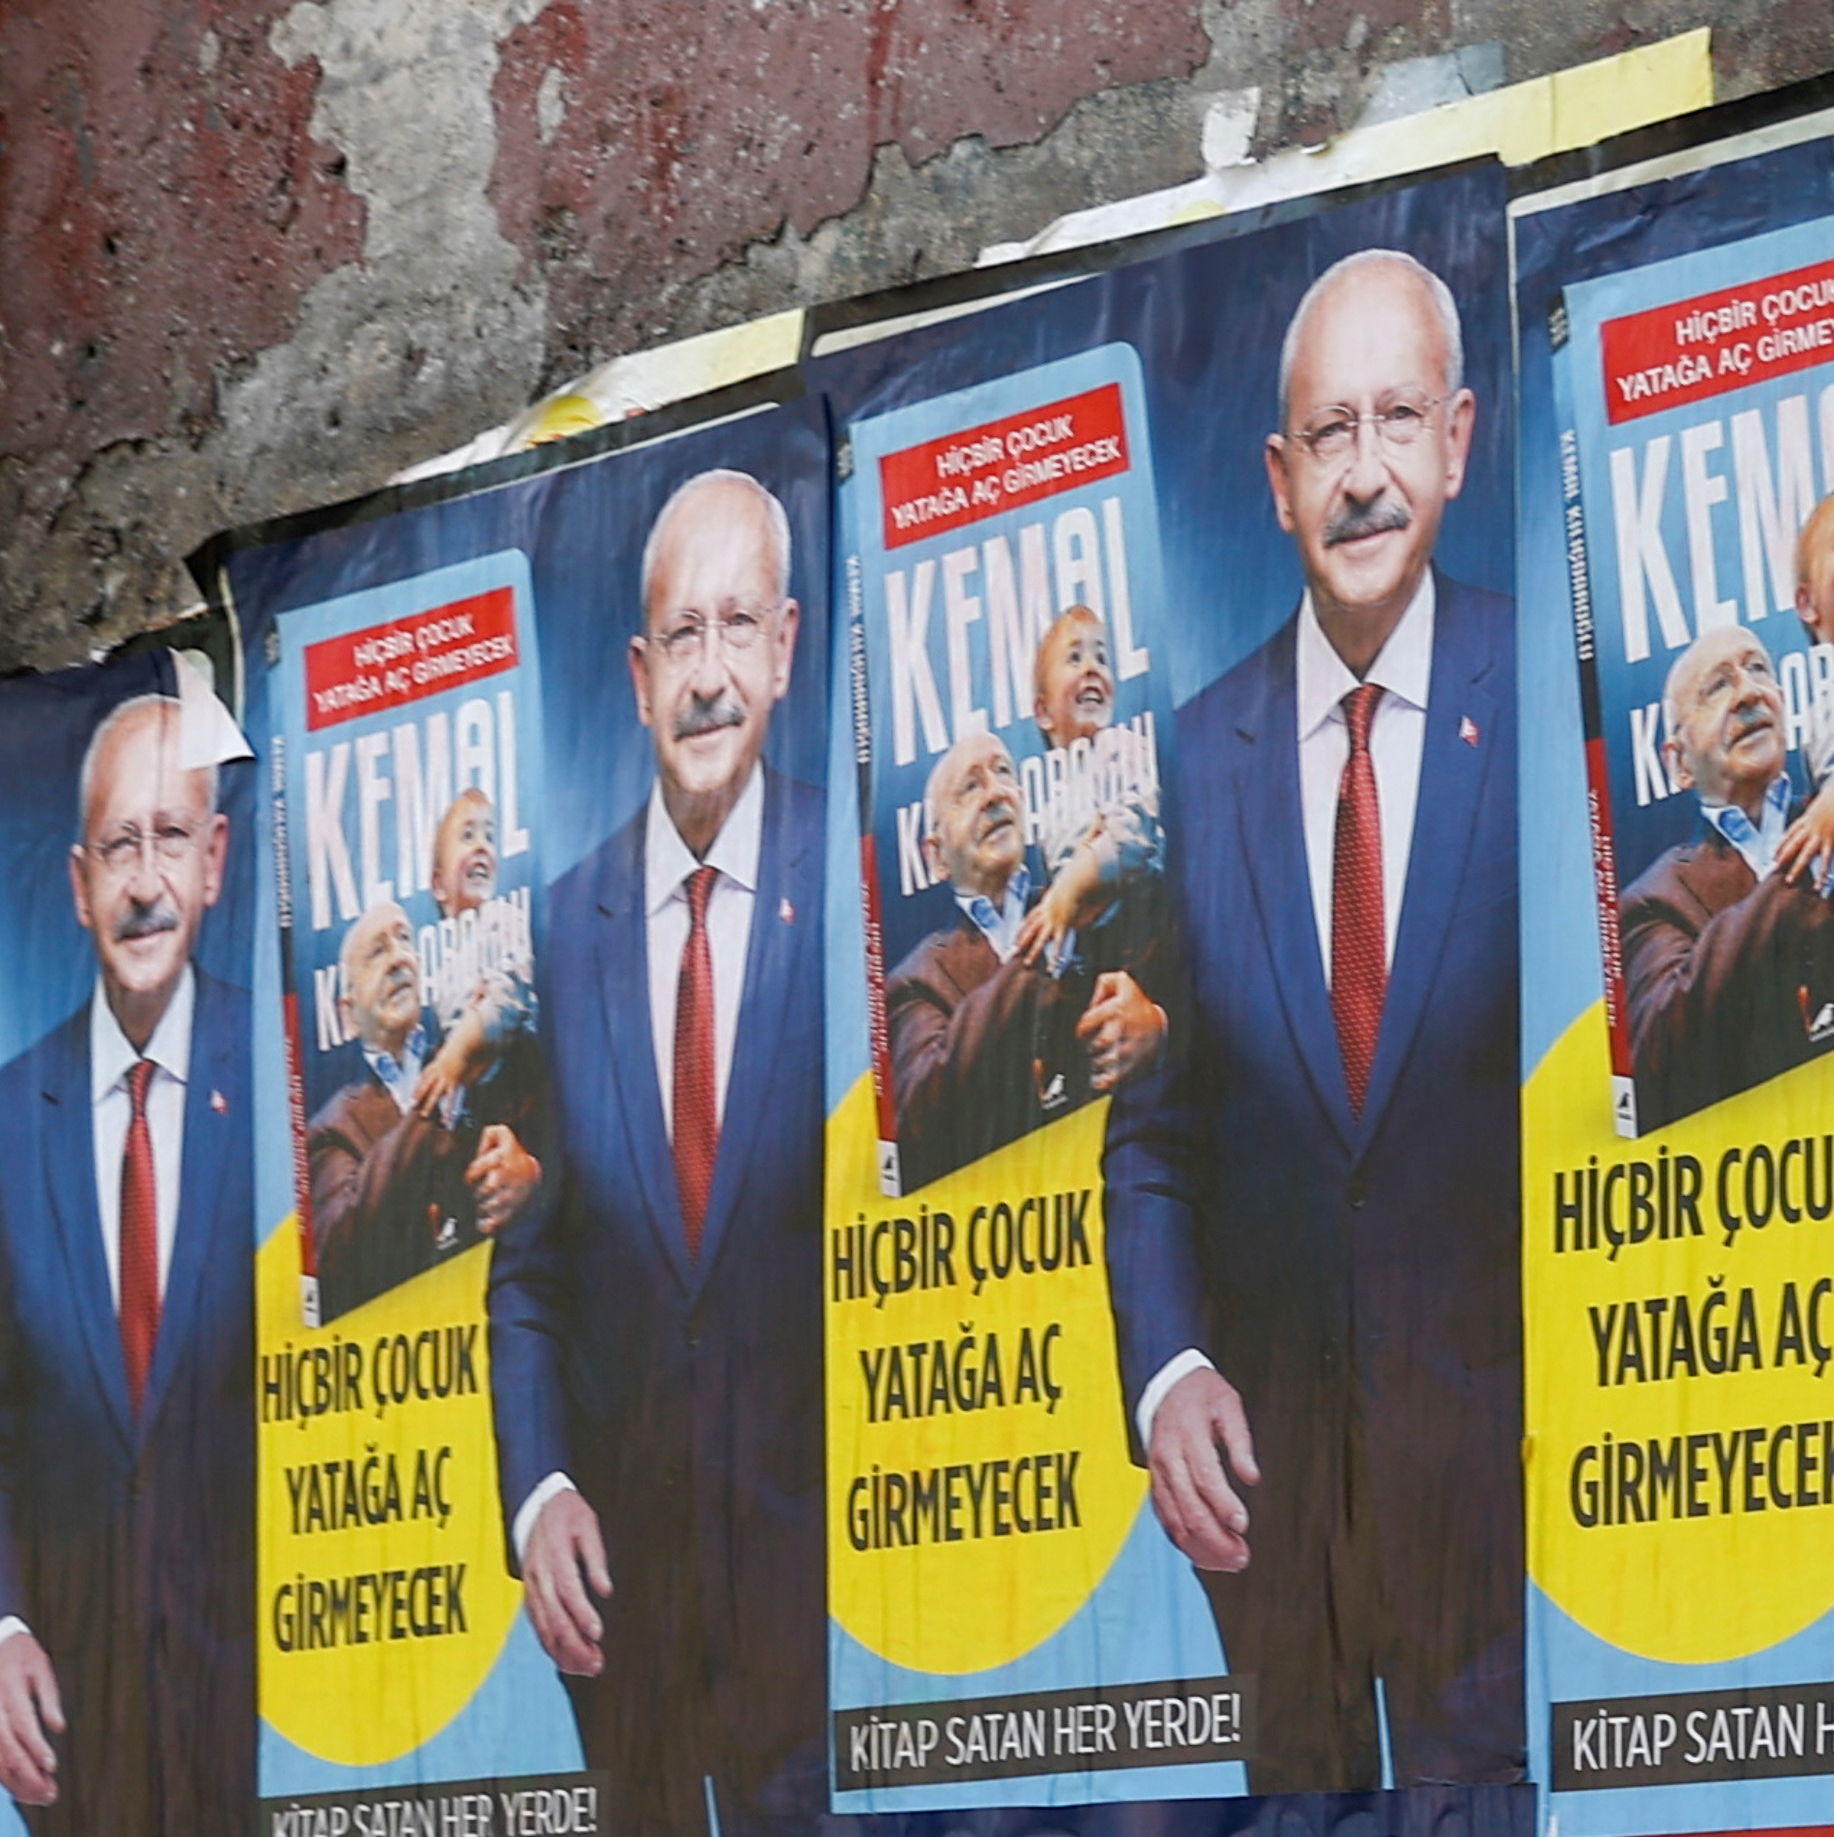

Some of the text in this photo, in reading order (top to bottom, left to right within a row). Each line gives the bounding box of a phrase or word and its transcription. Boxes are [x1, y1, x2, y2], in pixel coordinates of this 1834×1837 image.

[1676, 299, 1757, 347] HİÇBİR
[1617, 351, 1713, 403] YATAĞA
[1718, 340, 1753, 377] AÇ
[892, 438, 1122, 530] YATAĞA AÇ GİRMEYECEK
[937, 416, 1074, 480] HİÇBİR ÇOCUK
[1559, 429, 1581, 499] KEMAL
[1554, 1144, 1704, 1262] HİÇBİR
[832, 1189, 1092, 1310] HİÇBİR ÇOCUK
[858, 1322, 1062, 1424] YATAĞA AÇ
[1588, 1275, 1832, 1387] YATAĞA AÇ
[262, 1324, 478, 1430] HİÇBİR ÇOCUK
[285, 1445, 451, 1535] YATAĞA AÇ
[847, 1450, 1081, 1552] GİRMEYECEK
[272, 1563, 467, 1653] GİRMEYECEK
[851, 1715, 939, 1772] KİTAP
[945, 1709, 1045, 1765] SATAN
[1053, 1704, 1117, 1755] HER
[1573, 1708, 1677, 1771] KİTAP
[1684, 1703, 1805, 1764] SATAN
